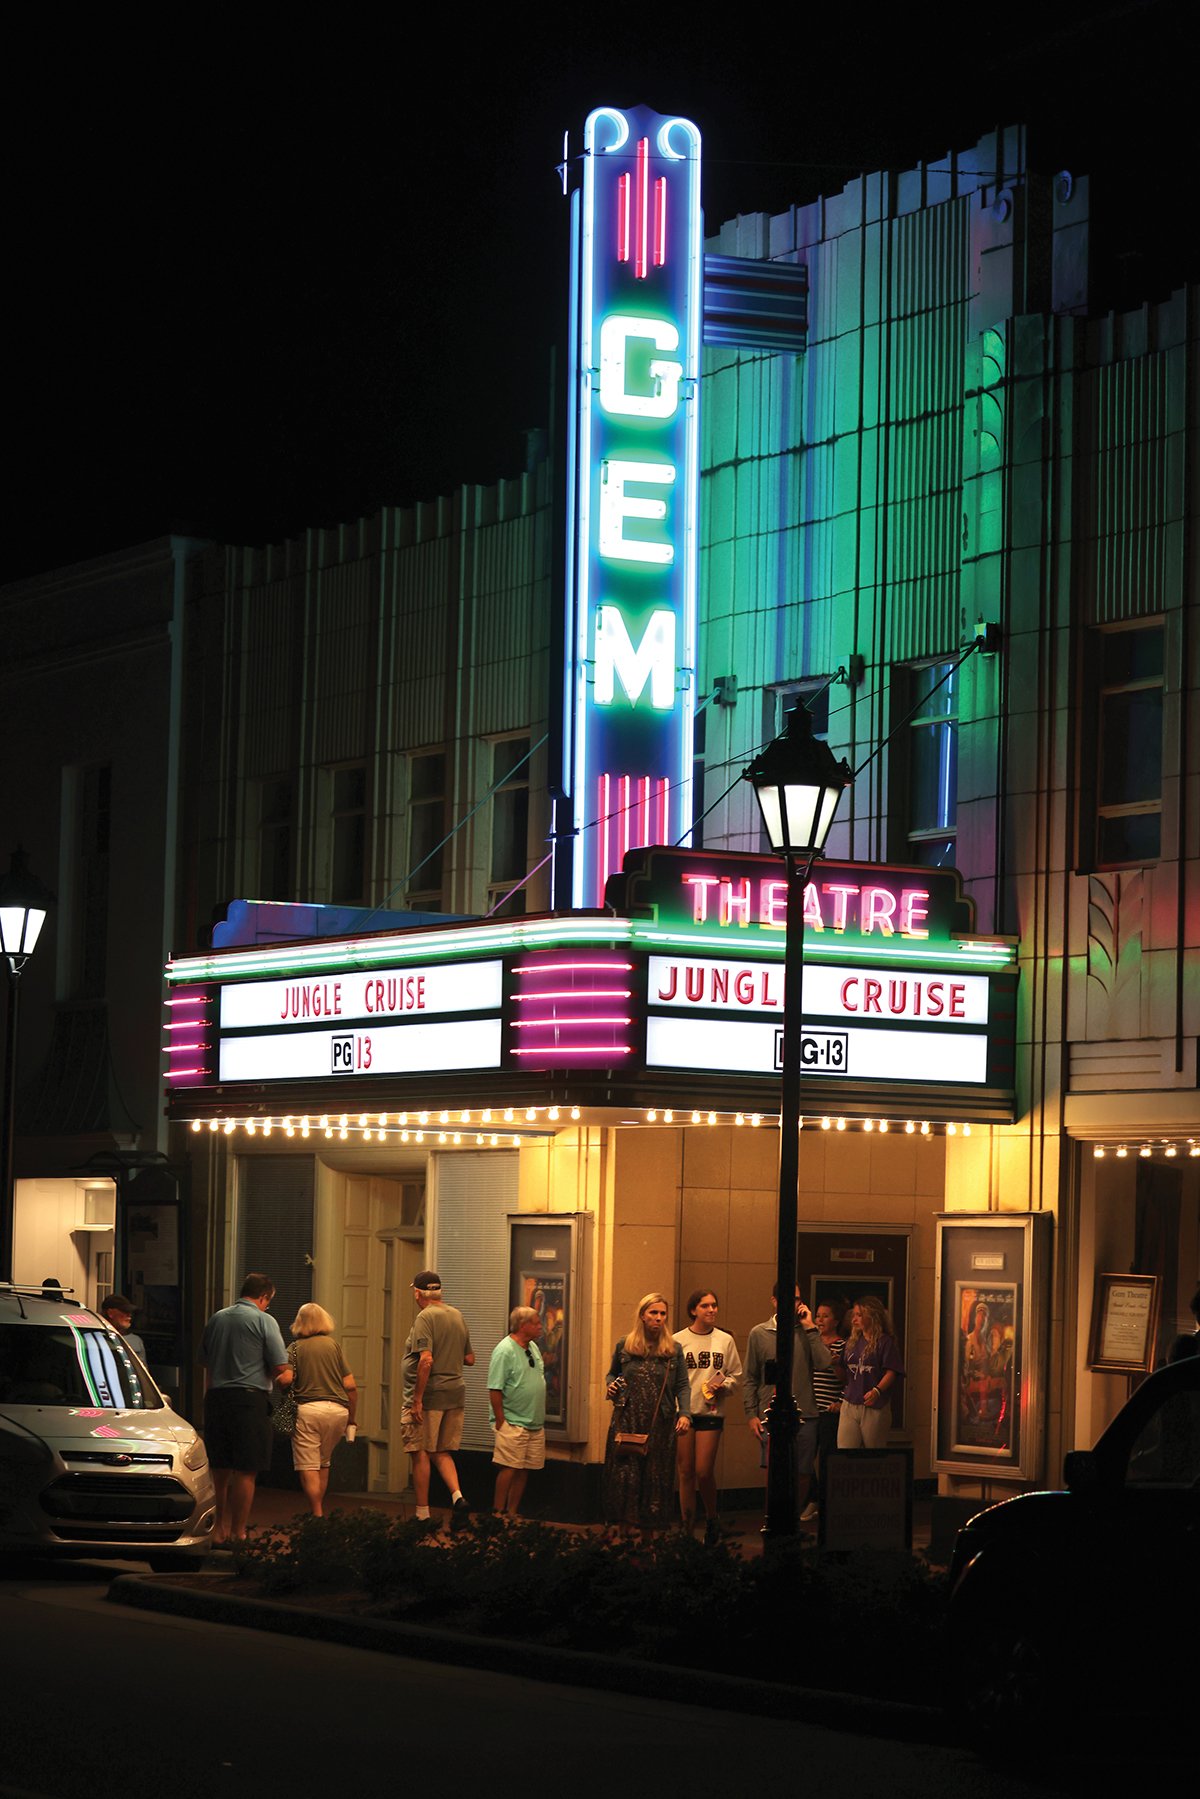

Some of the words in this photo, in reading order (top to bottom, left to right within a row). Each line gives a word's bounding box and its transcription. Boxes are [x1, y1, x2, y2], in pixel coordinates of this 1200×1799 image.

[593, 314, 680, 712] GEM
[681, 873, 929, 940] THEATRE
[281, 983, 342, 1019] JUNGLE
[365, 976, 426, 1013] CRUISE
[658, 966, 786, 1007] JUNGL
[840, 977, 966, 1018] CRUISE
[779, 1038, 843, 1066] G-13
[686, 1351, 724, 1370] ASU
